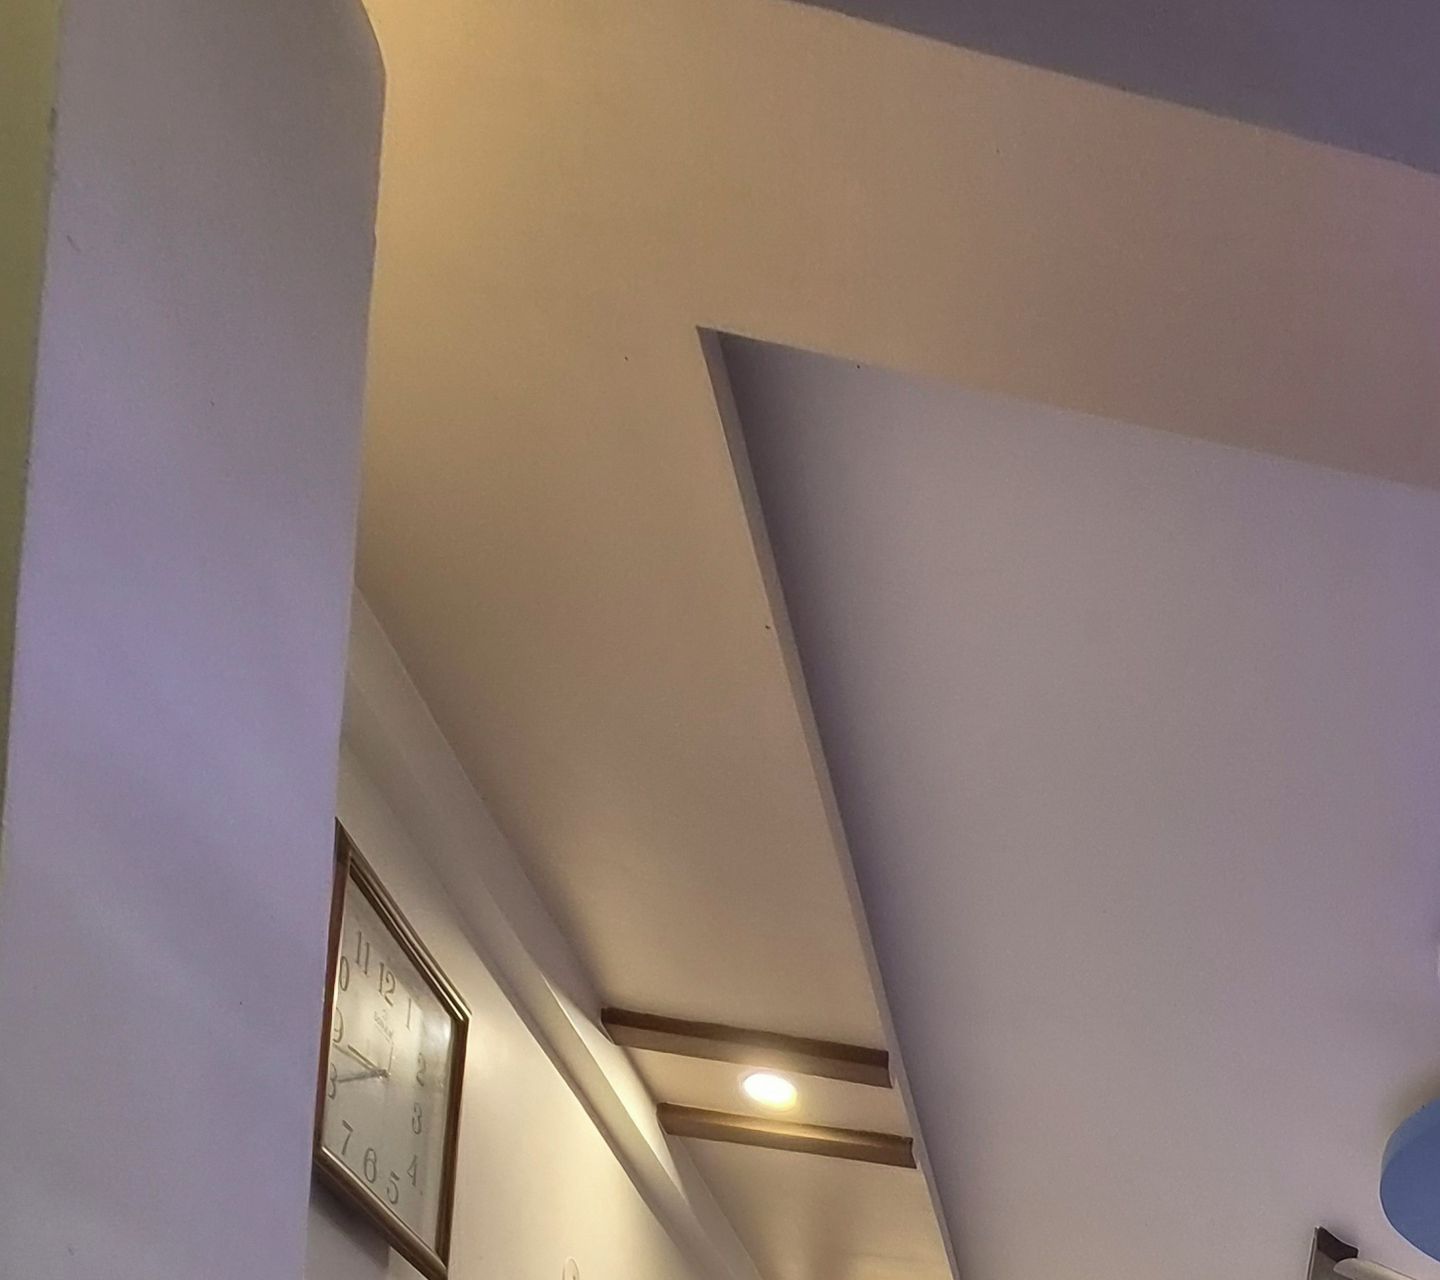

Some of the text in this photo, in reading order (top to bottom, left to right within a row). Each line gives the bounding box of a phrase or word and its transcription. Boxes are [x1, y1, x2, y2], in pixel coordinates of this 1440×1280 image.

[356, 931, 370, 976] 11
[339, 955, 350, 992] 0
[379, 961, 396, 1007] 12
[406, 998, 412, 1032] 1
[416, 1051, 426, 1087] 2
[411, 1102, 423, 1135] 3
[341, 1119, 354, 1156] 7
[364, 1147, 377, 1184] 6
[406, 1154, 418, 1187] 4
[386, 1170, 400, 1205] 5
